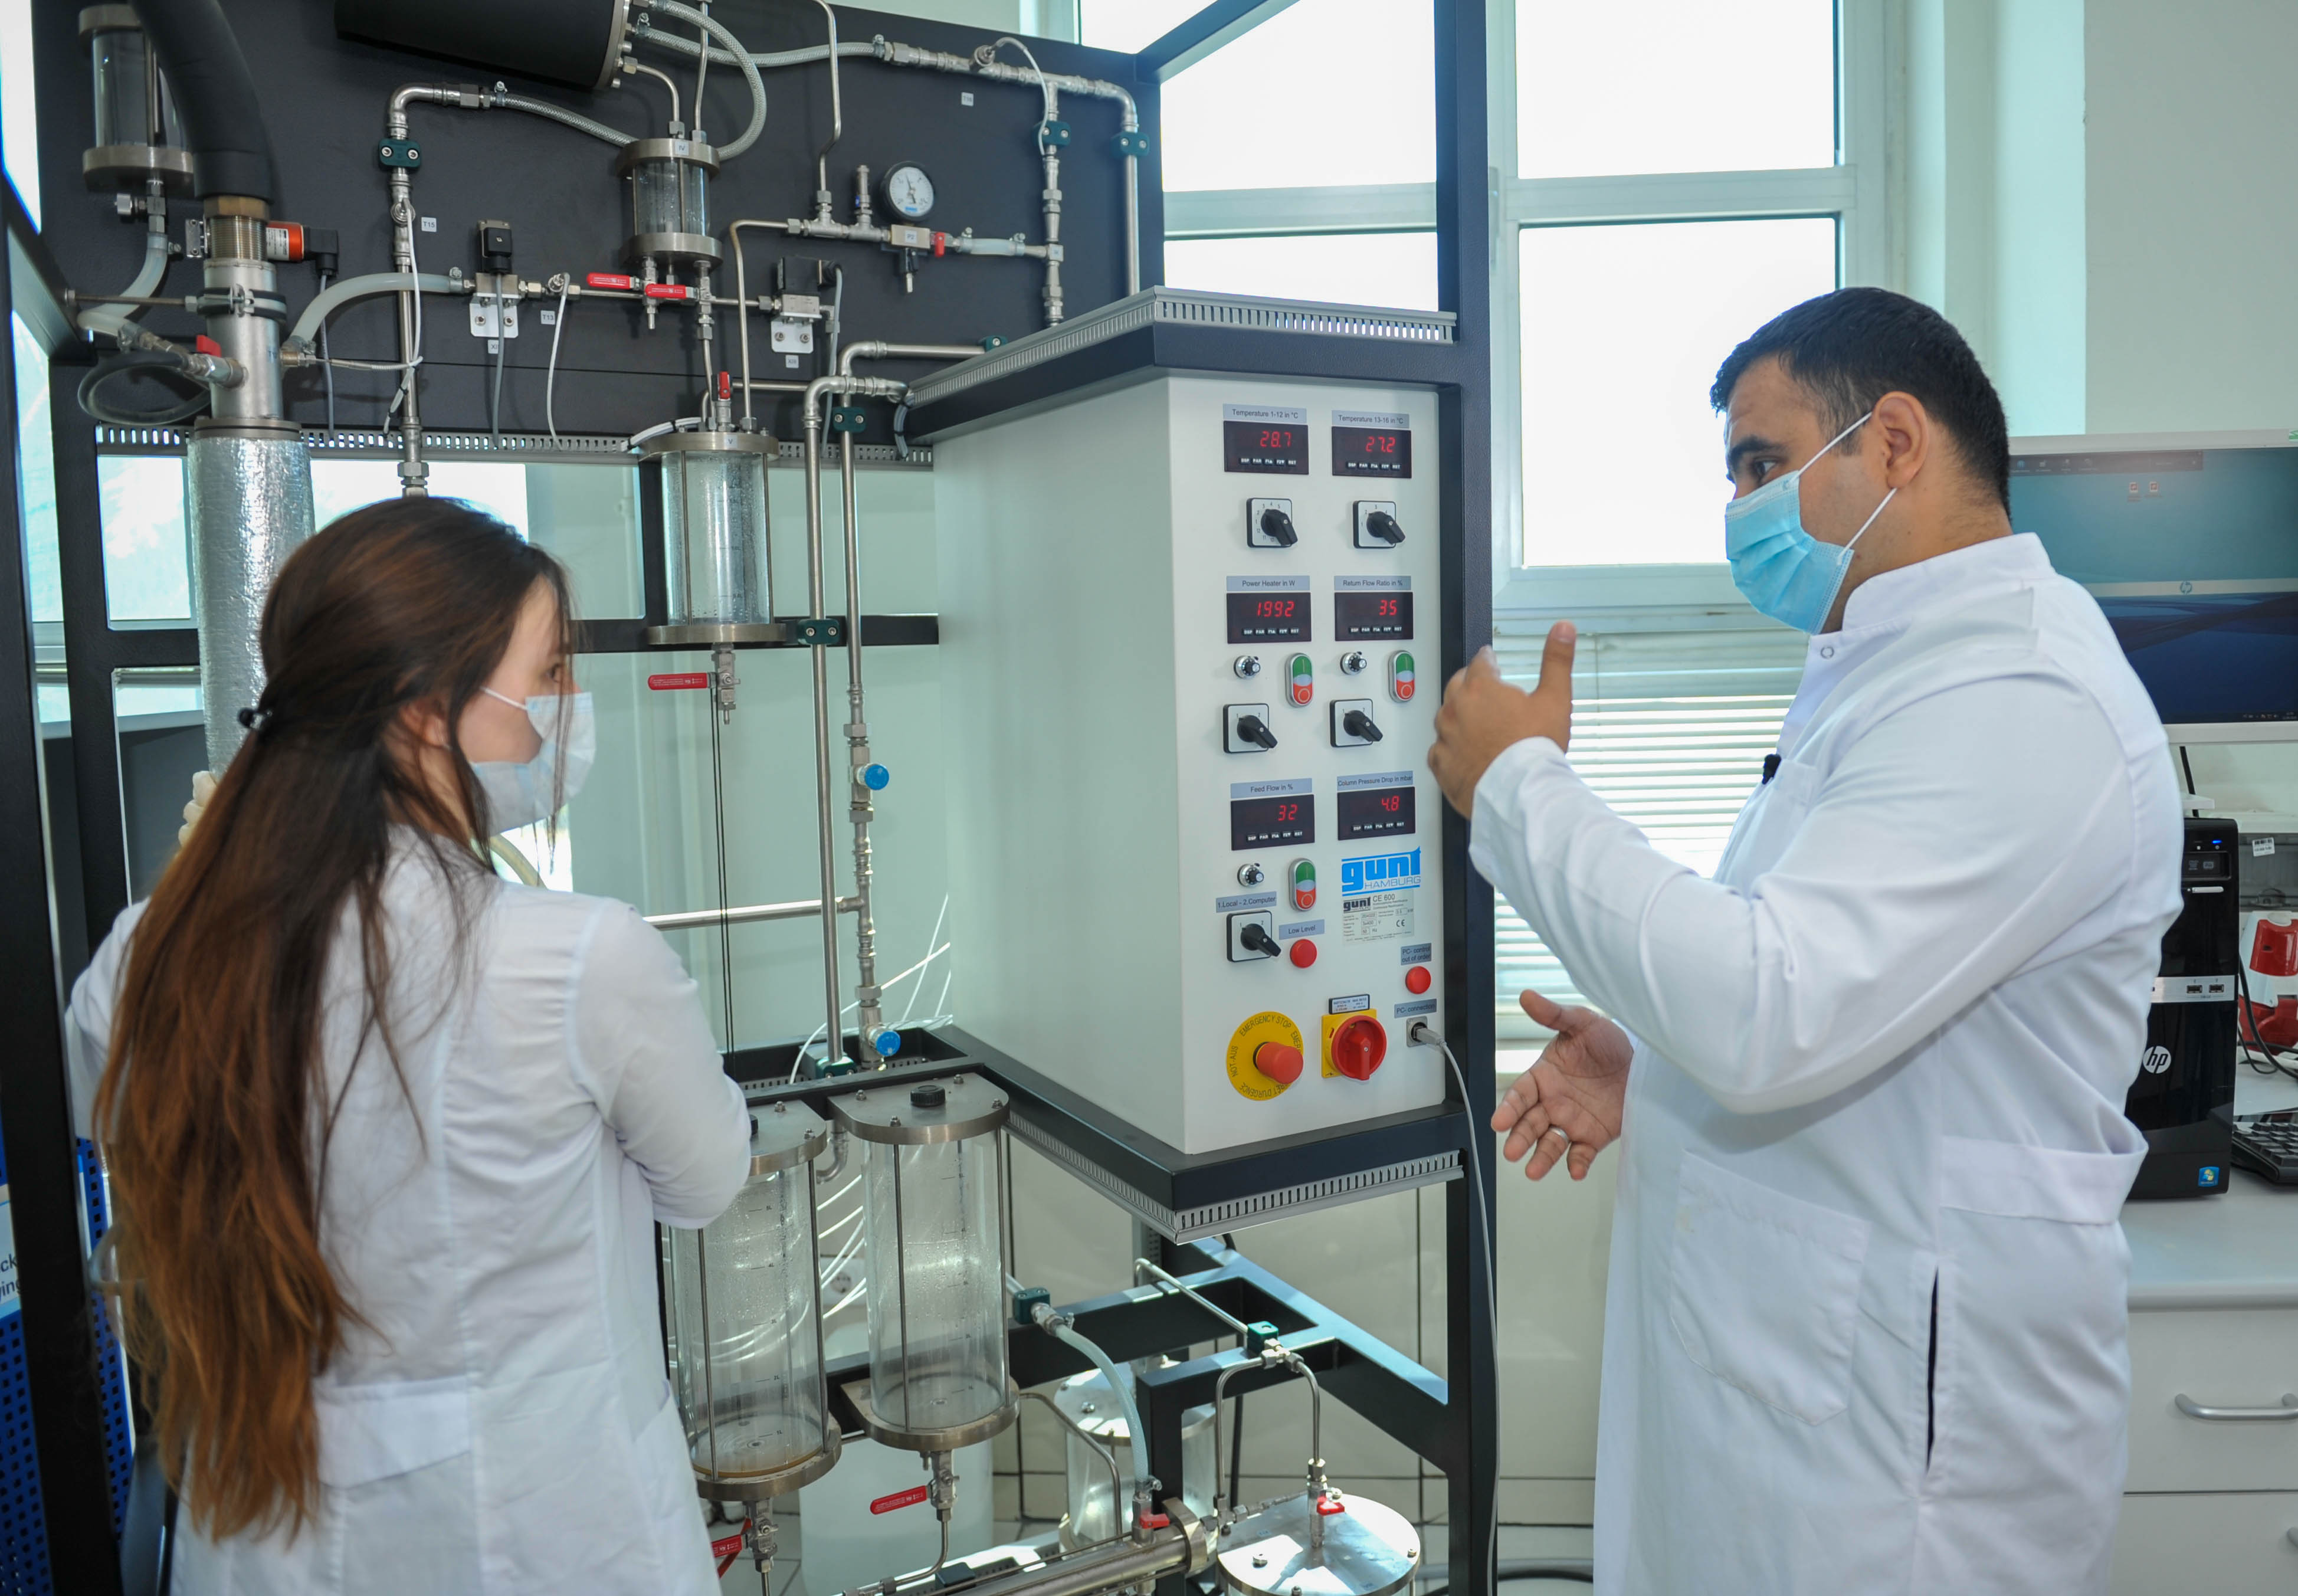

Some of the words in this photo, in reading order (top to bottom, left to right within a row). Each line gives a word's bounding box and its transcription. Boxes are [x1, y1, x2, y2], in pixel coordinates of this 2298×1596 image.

[1232, 409, 1268, 417] Temperature
[1260, 430, 1292, 448] 28.7
[1365, 435, 1396, 453] 27.2
[1257, 601, 1295, 617] 1992
[1379, 599, 1398, 616] 35
[1381, 795, 1400, 811] 4.8
[1278, 804, 1298, 821] 32
[1342, 845, 1421, 892] gunt
[1365, 876, 1421, 889] HAMBURG
[1243, 897, 1276, 905] 2.Computer
[1343, 896, 1371, 912] gunt
[1408, 1004, 1435, 1012] connection
[1239, 1015, 1275, 1037] EMERGENCY
[1276, 1016, 1291, 1028] STOP
[2144, 1046, 2170, 1074] hp
